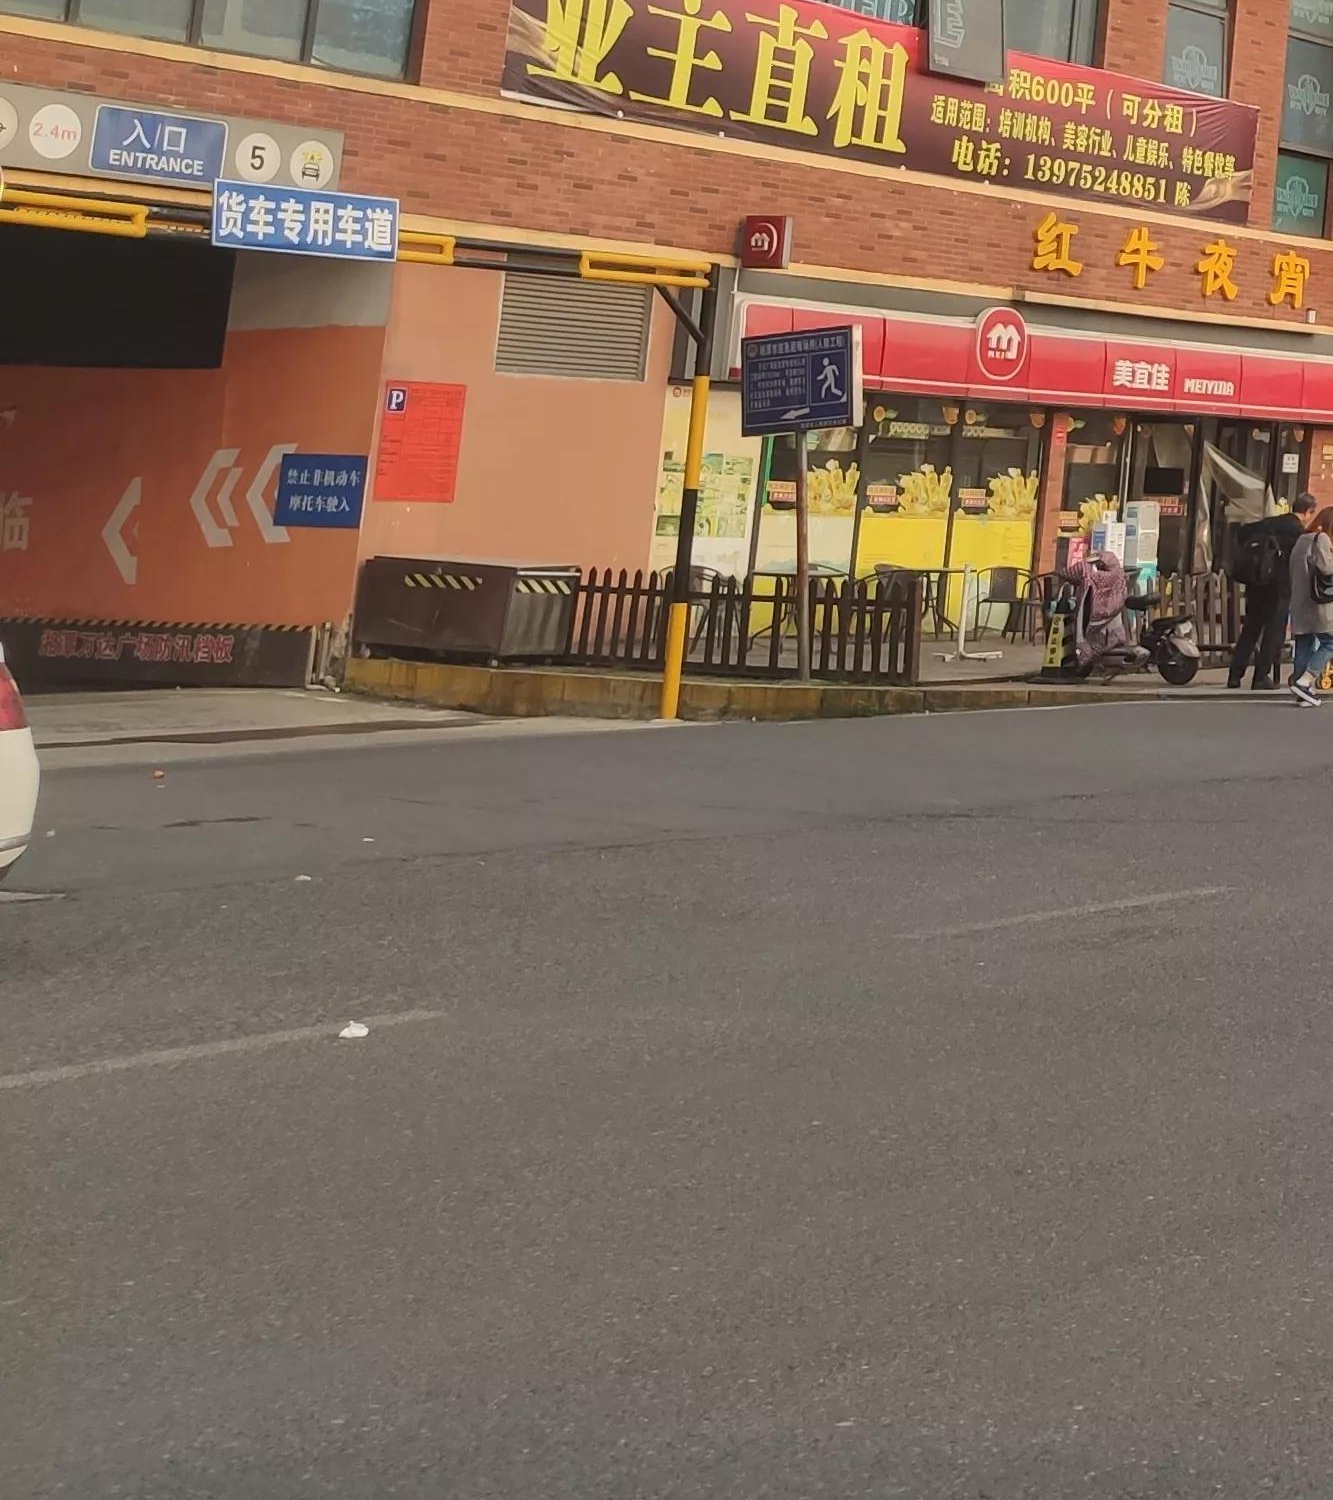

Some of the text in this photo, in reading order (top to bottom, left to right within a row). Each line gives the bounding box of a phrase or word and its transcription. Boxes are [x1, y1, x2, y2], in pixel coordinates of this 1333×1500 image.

[32, 122, 78, 142] 2.4m
[108, 148, 205, 177] ENTRANCE
[250, 145, 266, 171] 5
[1174, 180, 1194, 208] 陈
[218, 189, 394, 253] 货车专用车道
[1031, 211, 1311, 310] 红牛夜宵
[1112, 359, 1170, 392] 美宜佳
[389, 389, 405, 411] P
[286, 467, 362, 488] 禁止非机动车
[288, 494, 351, 513] 摩托车驶入
